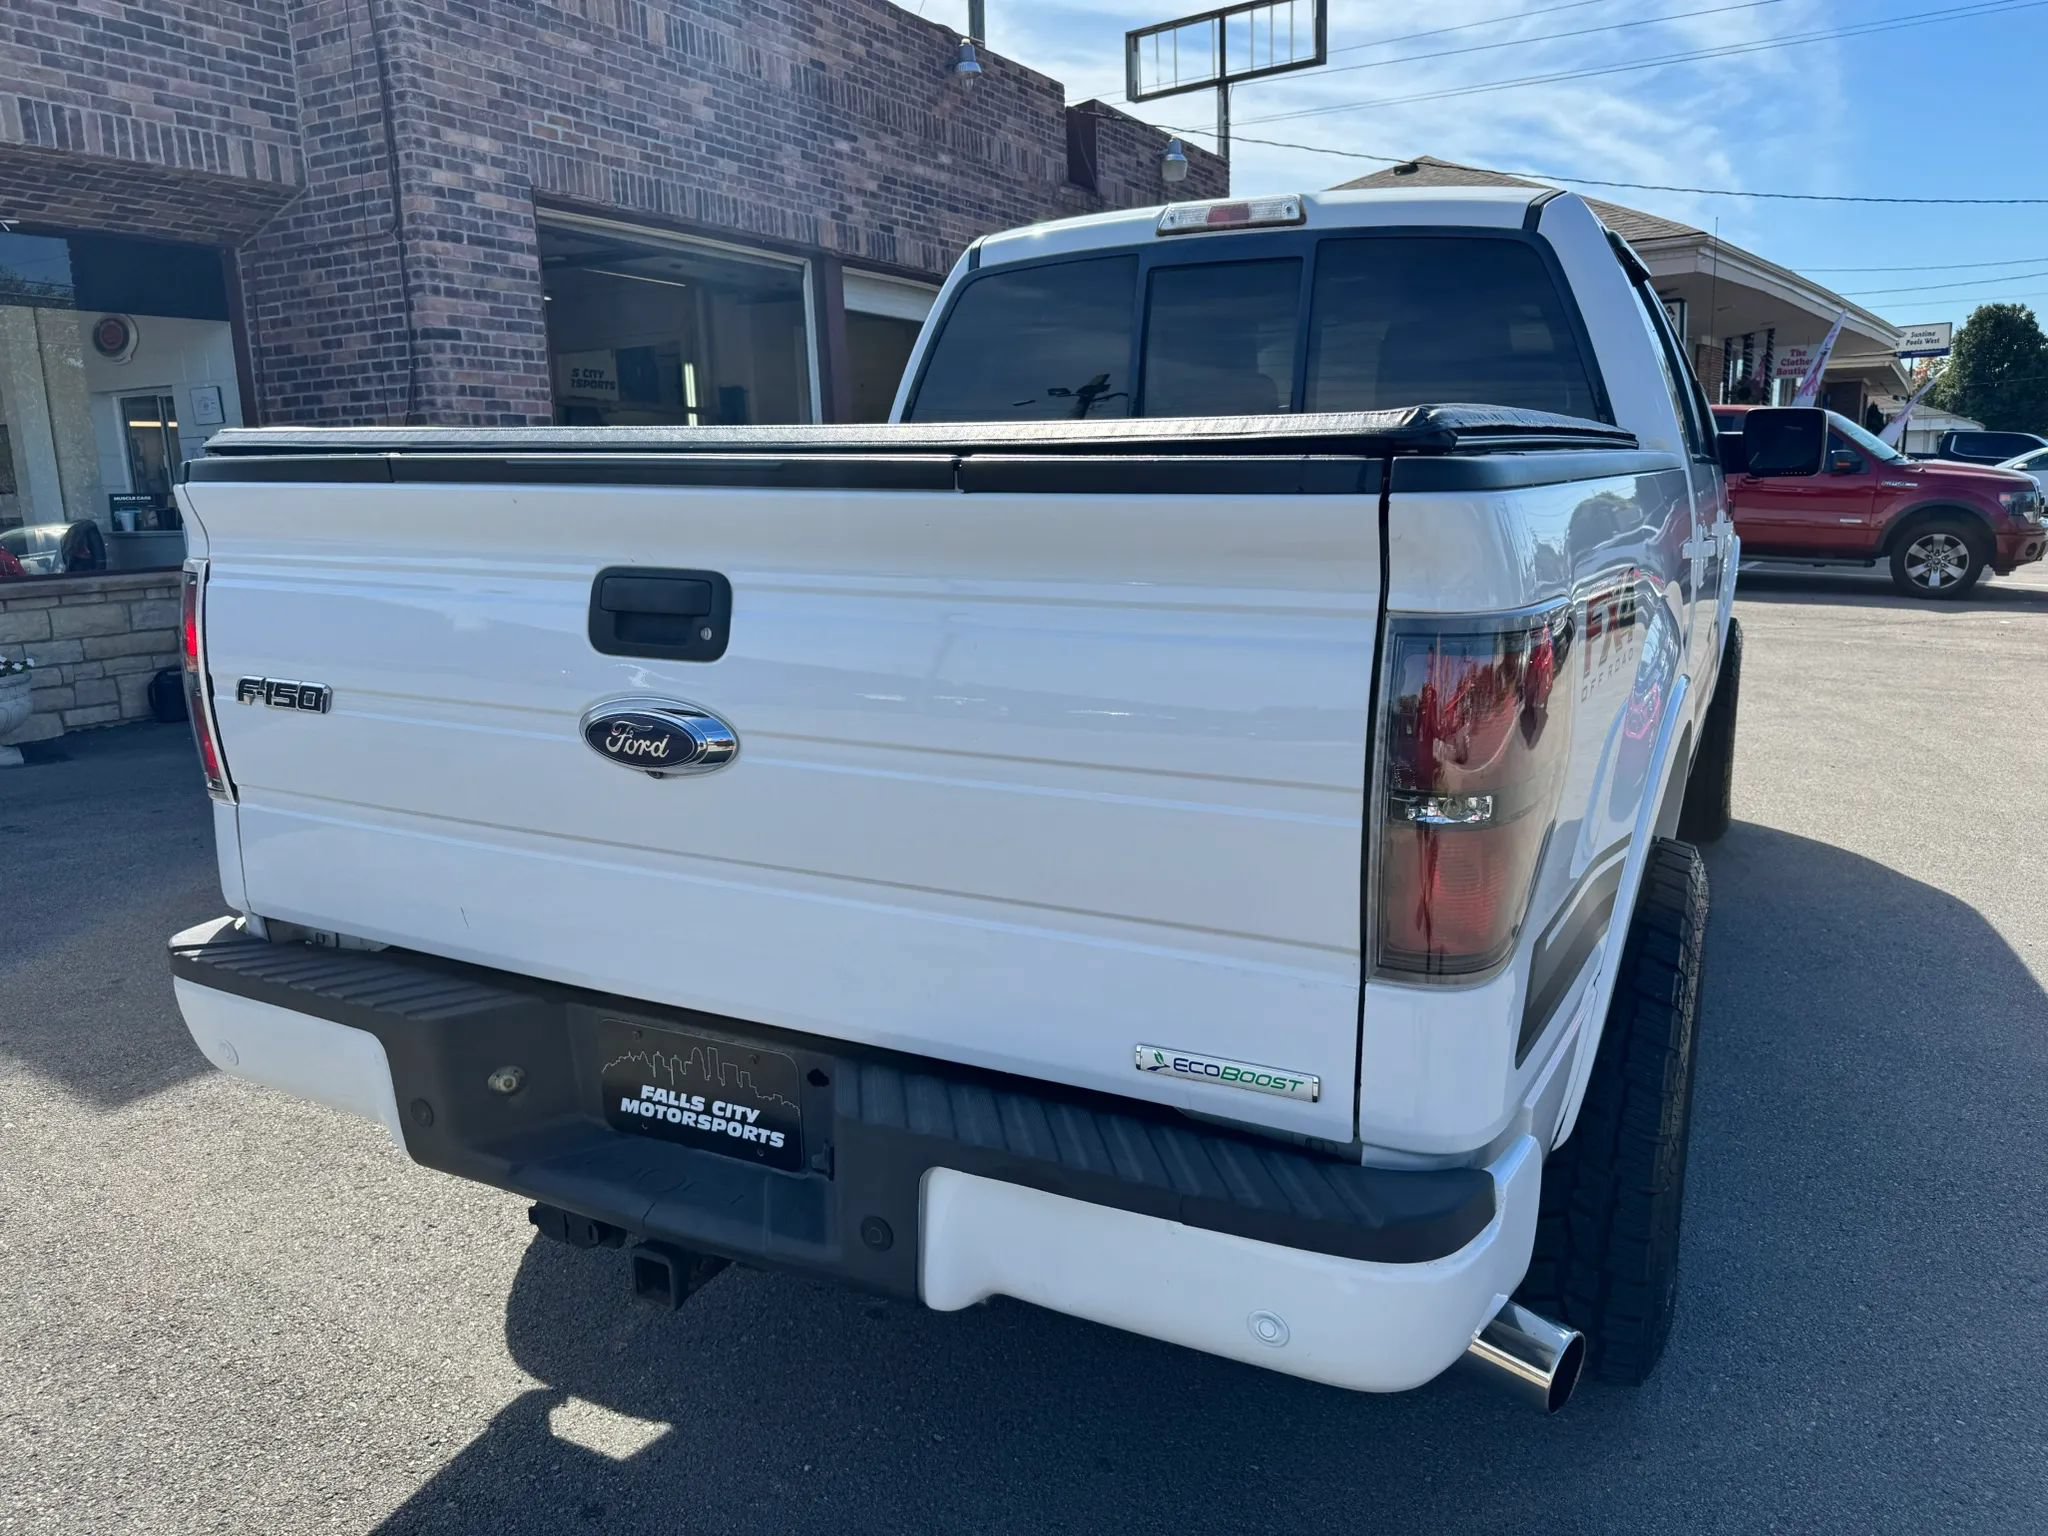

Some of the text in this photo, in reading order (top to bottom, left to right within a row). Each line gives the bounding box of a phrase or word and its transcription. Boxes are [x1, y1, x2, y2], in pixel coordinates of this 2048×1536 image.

[1790, 348, 1808, 357] The
[1925, 337, 1940, 345] West
[583, 368, 605, 379] CITY
[1580, 647, 1635, 703] OFF ROAD
[236, 676, 333, 714] F-150
[605, 720, 672, 758] Ford
[1173, 1057, 1304, 1092] ECOBOOST
[620, 1097, 786, 1148] MOTORSPORTS
[640, 1084, 761, 1123] FALLS CITY
